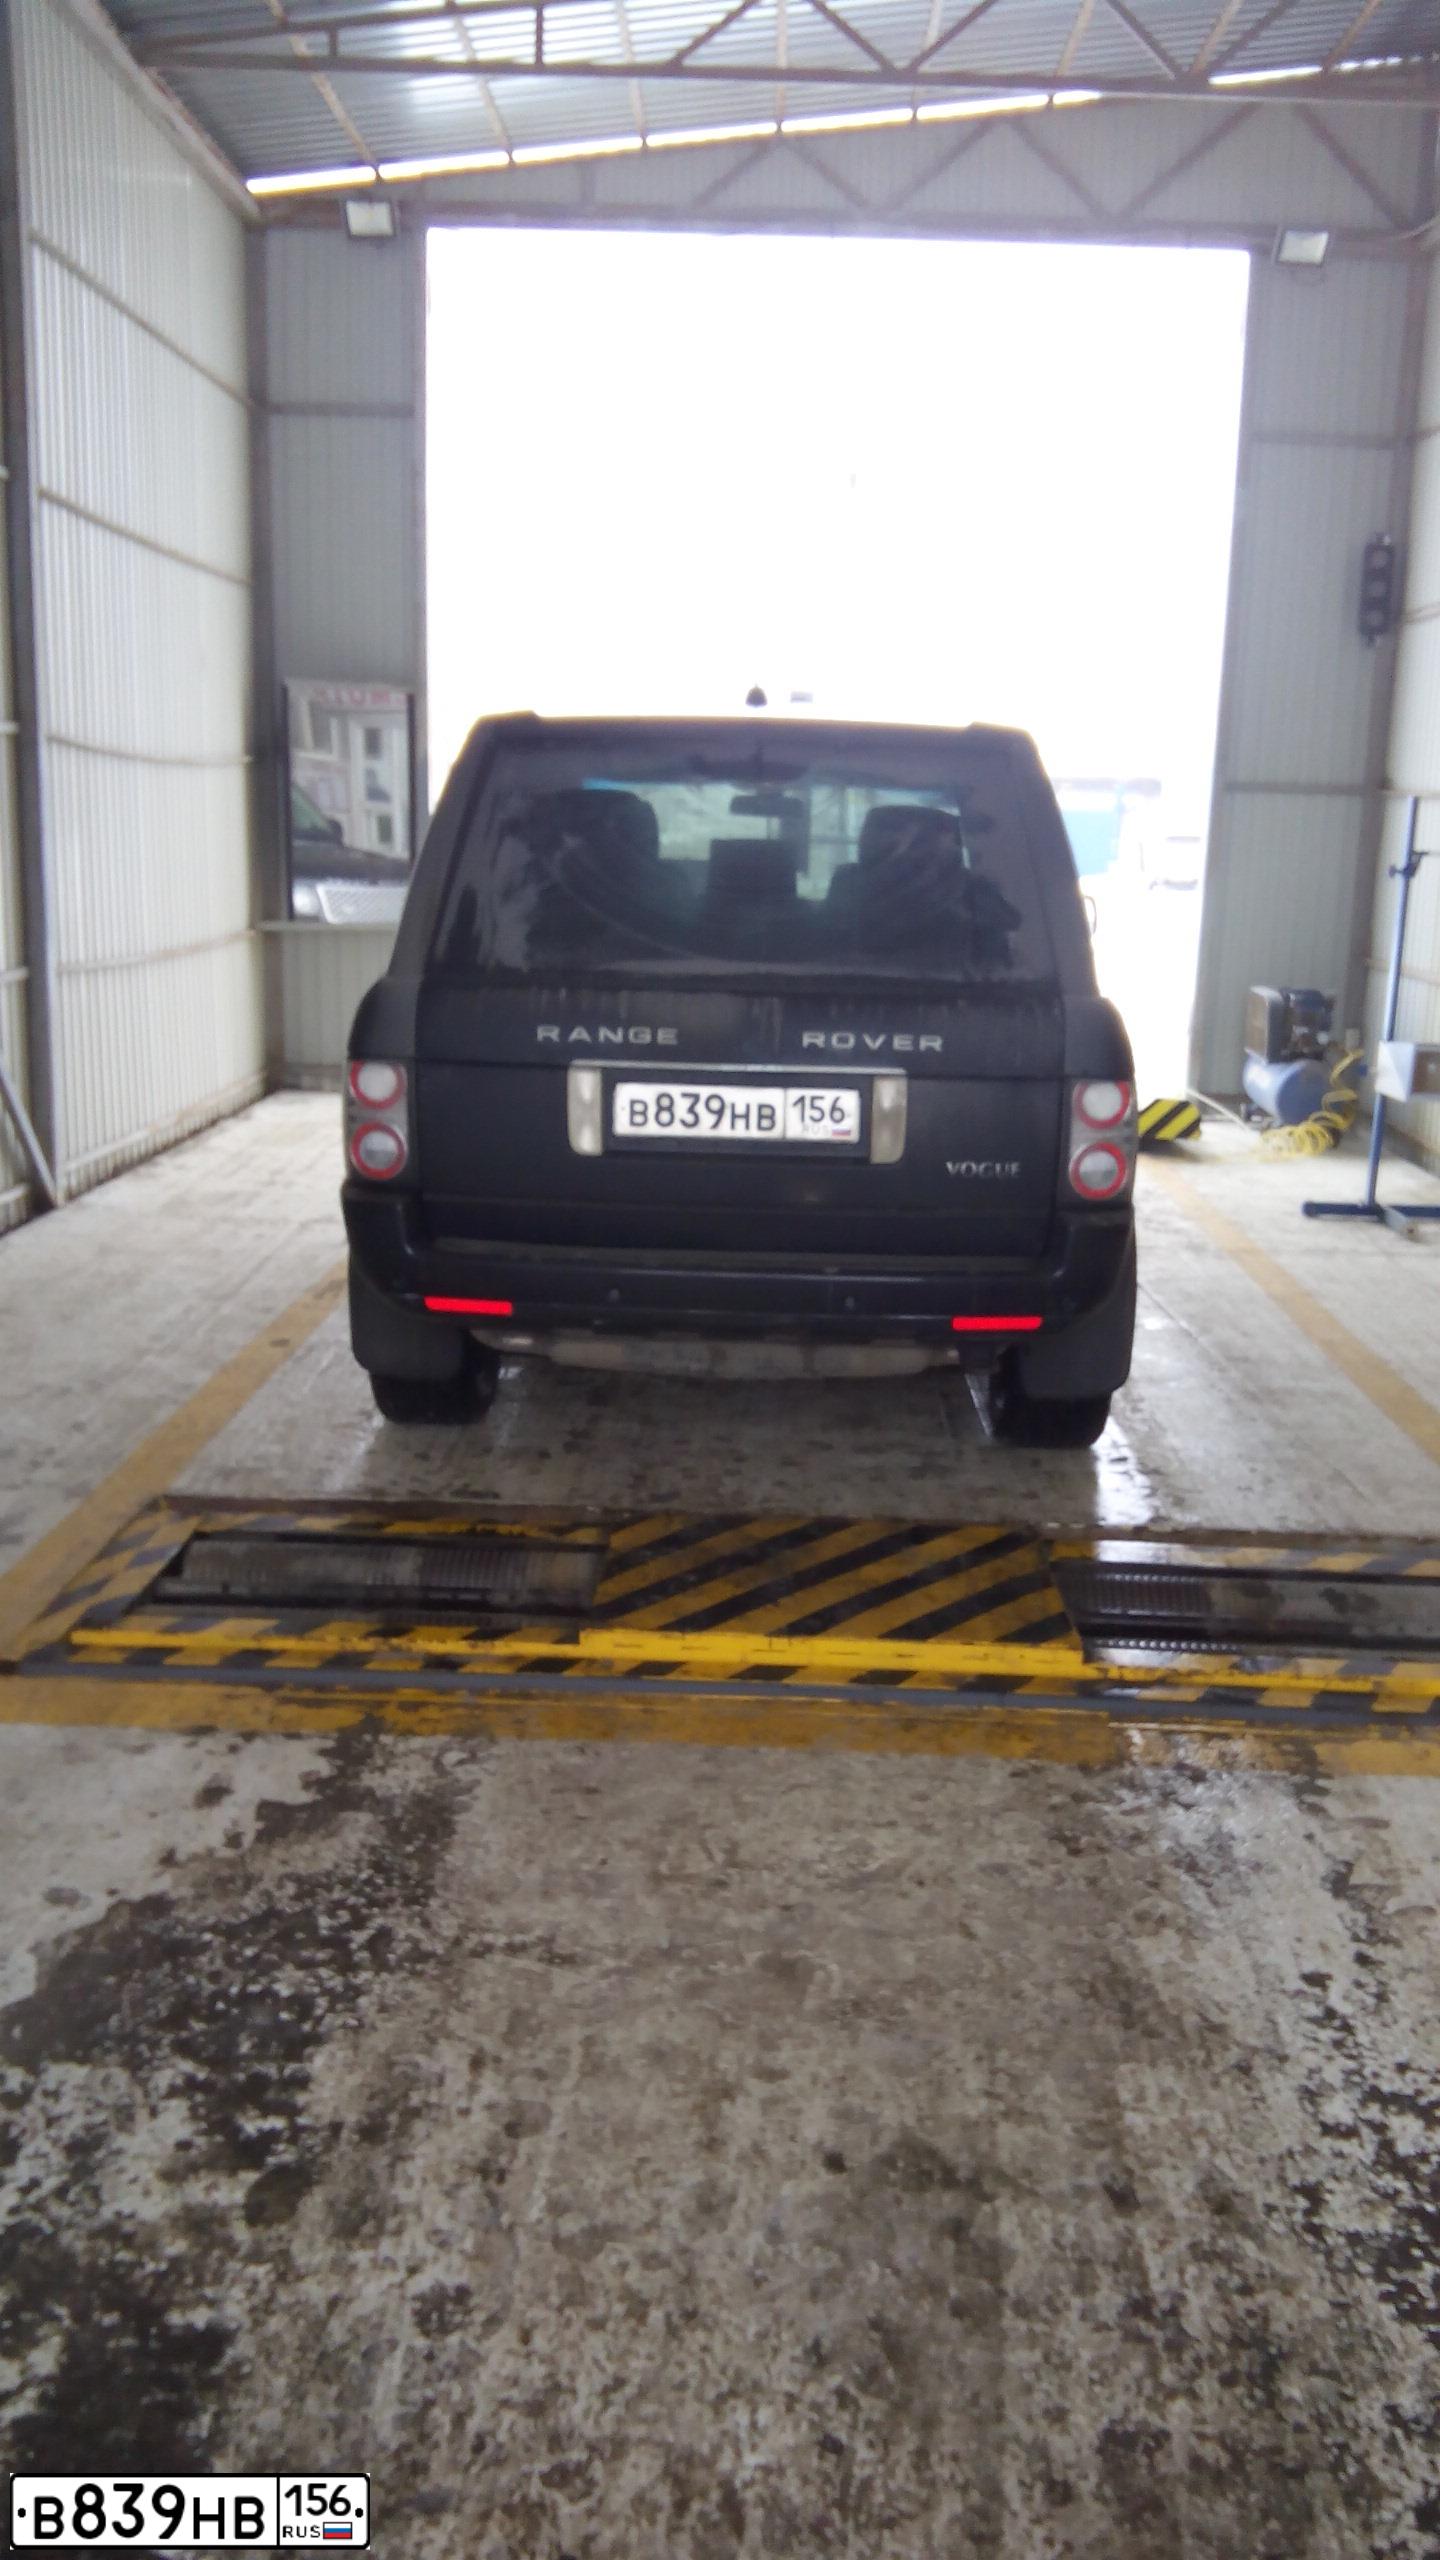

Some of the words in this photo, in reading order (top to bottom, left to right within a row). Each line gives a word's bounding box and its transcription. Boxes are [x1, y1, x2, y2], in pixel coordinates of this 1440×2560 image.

[536, 1024, 679, 1046] RANGE
[801, 1031, 944, 1053] ROVER
[628, 1092, 776, 1131] B839HB
[792, 1095, 846, 1124] 156
